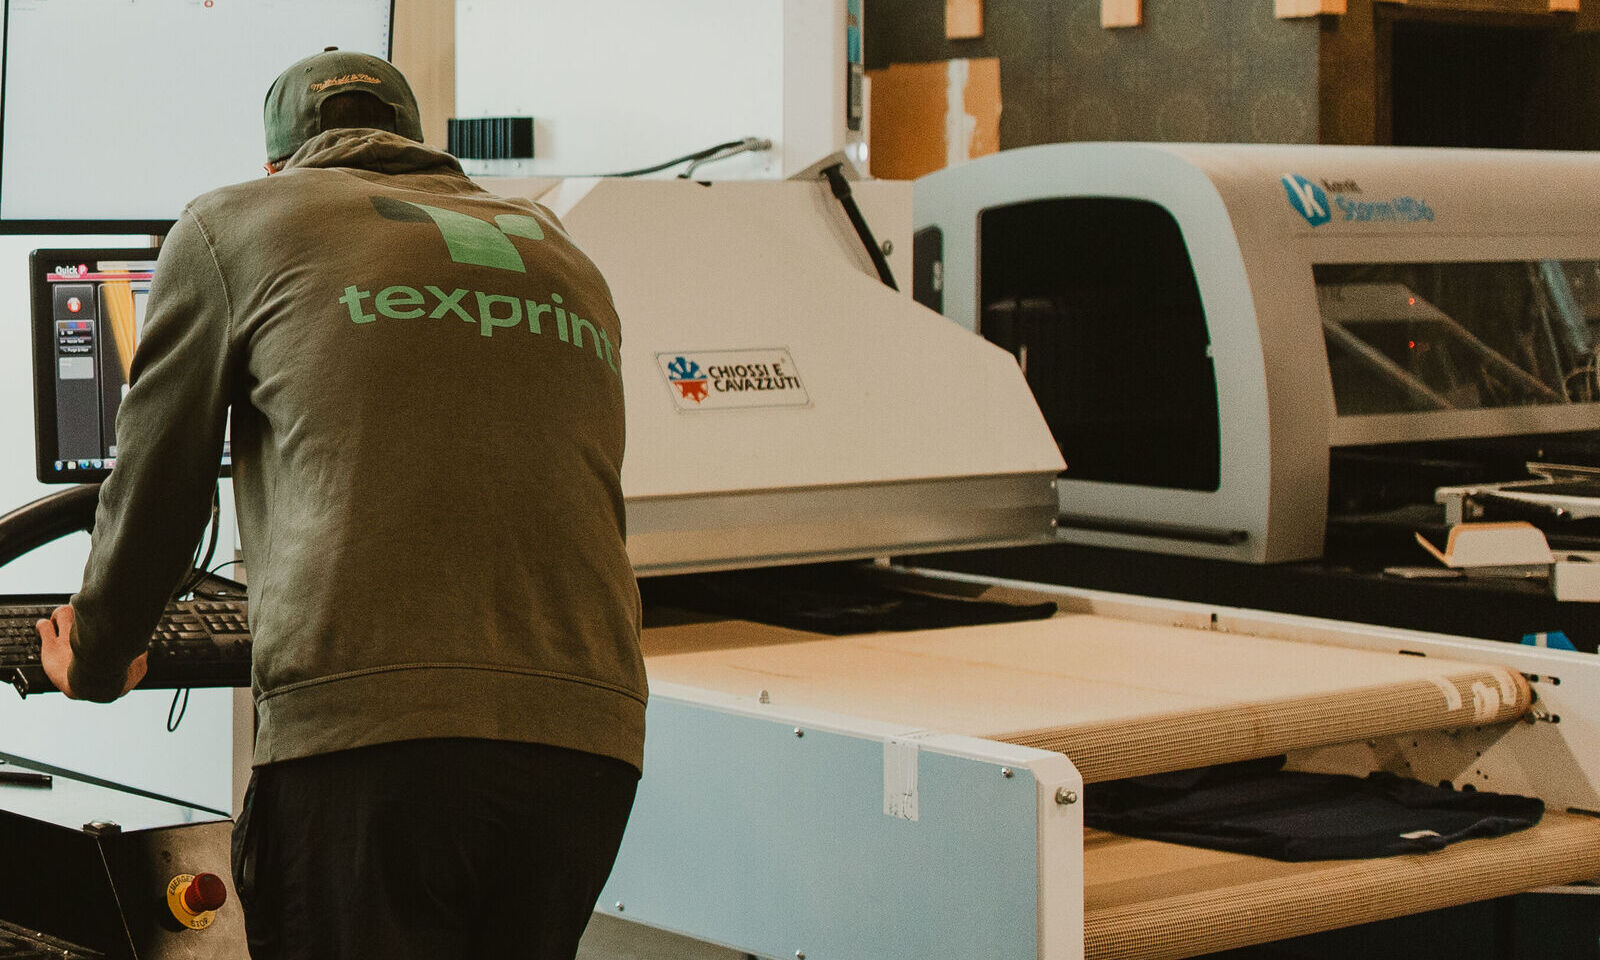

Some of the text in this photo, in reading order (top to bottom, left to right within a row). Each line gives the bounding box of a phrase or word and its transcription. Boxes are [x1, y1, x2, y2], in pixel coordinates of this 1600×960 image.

[338, 284, 618, 375] texprint
[708, 363, 784, 379] CHIOSSI E
[714, 376, 800, 392] CAVAZZUTI
[191, 917, 208, 928] STOP
